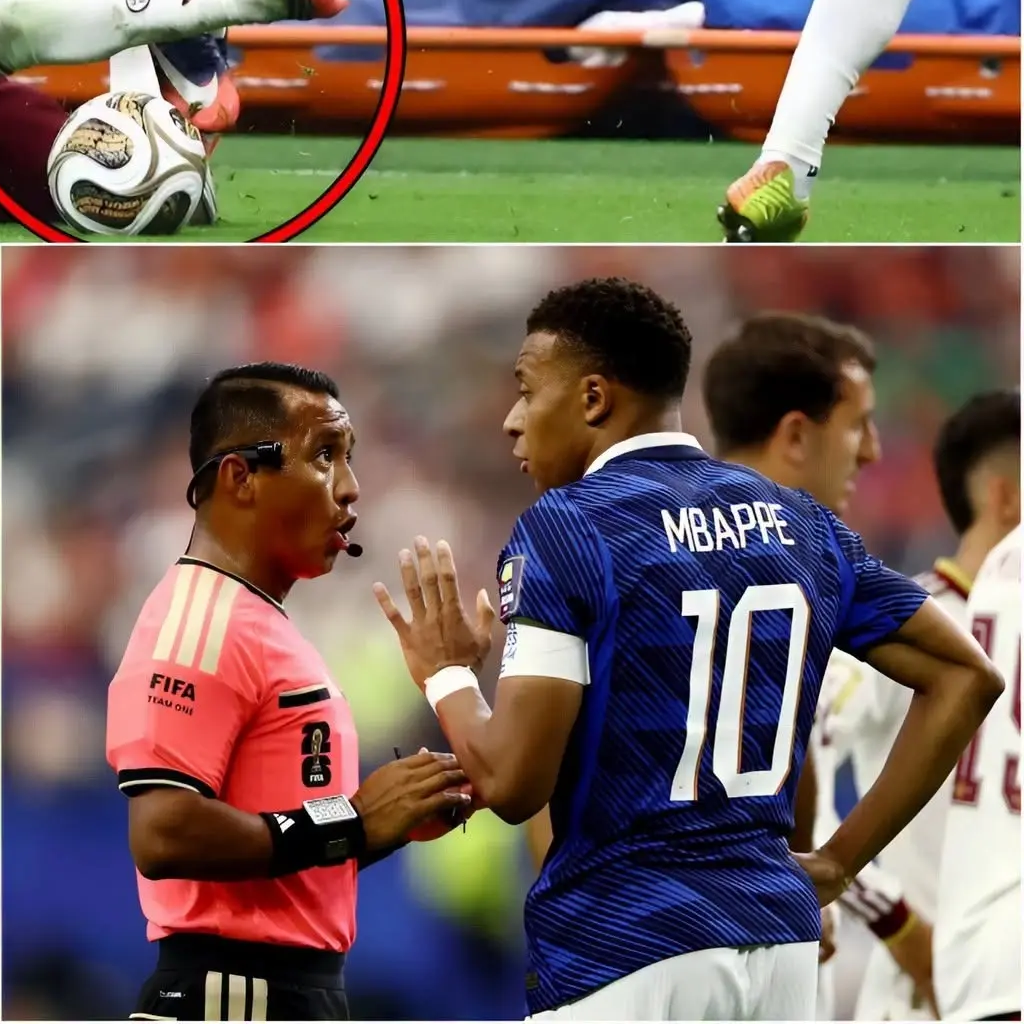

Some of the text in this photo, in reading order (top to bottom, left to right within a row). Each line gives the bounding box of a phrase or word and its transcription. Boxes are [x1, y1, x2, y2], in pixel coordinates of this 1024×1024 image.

[660, 500, 796, 553] MBAPPE
[149, 672, 196, 702] FIFA
[669, 582, 812, 802] 10
